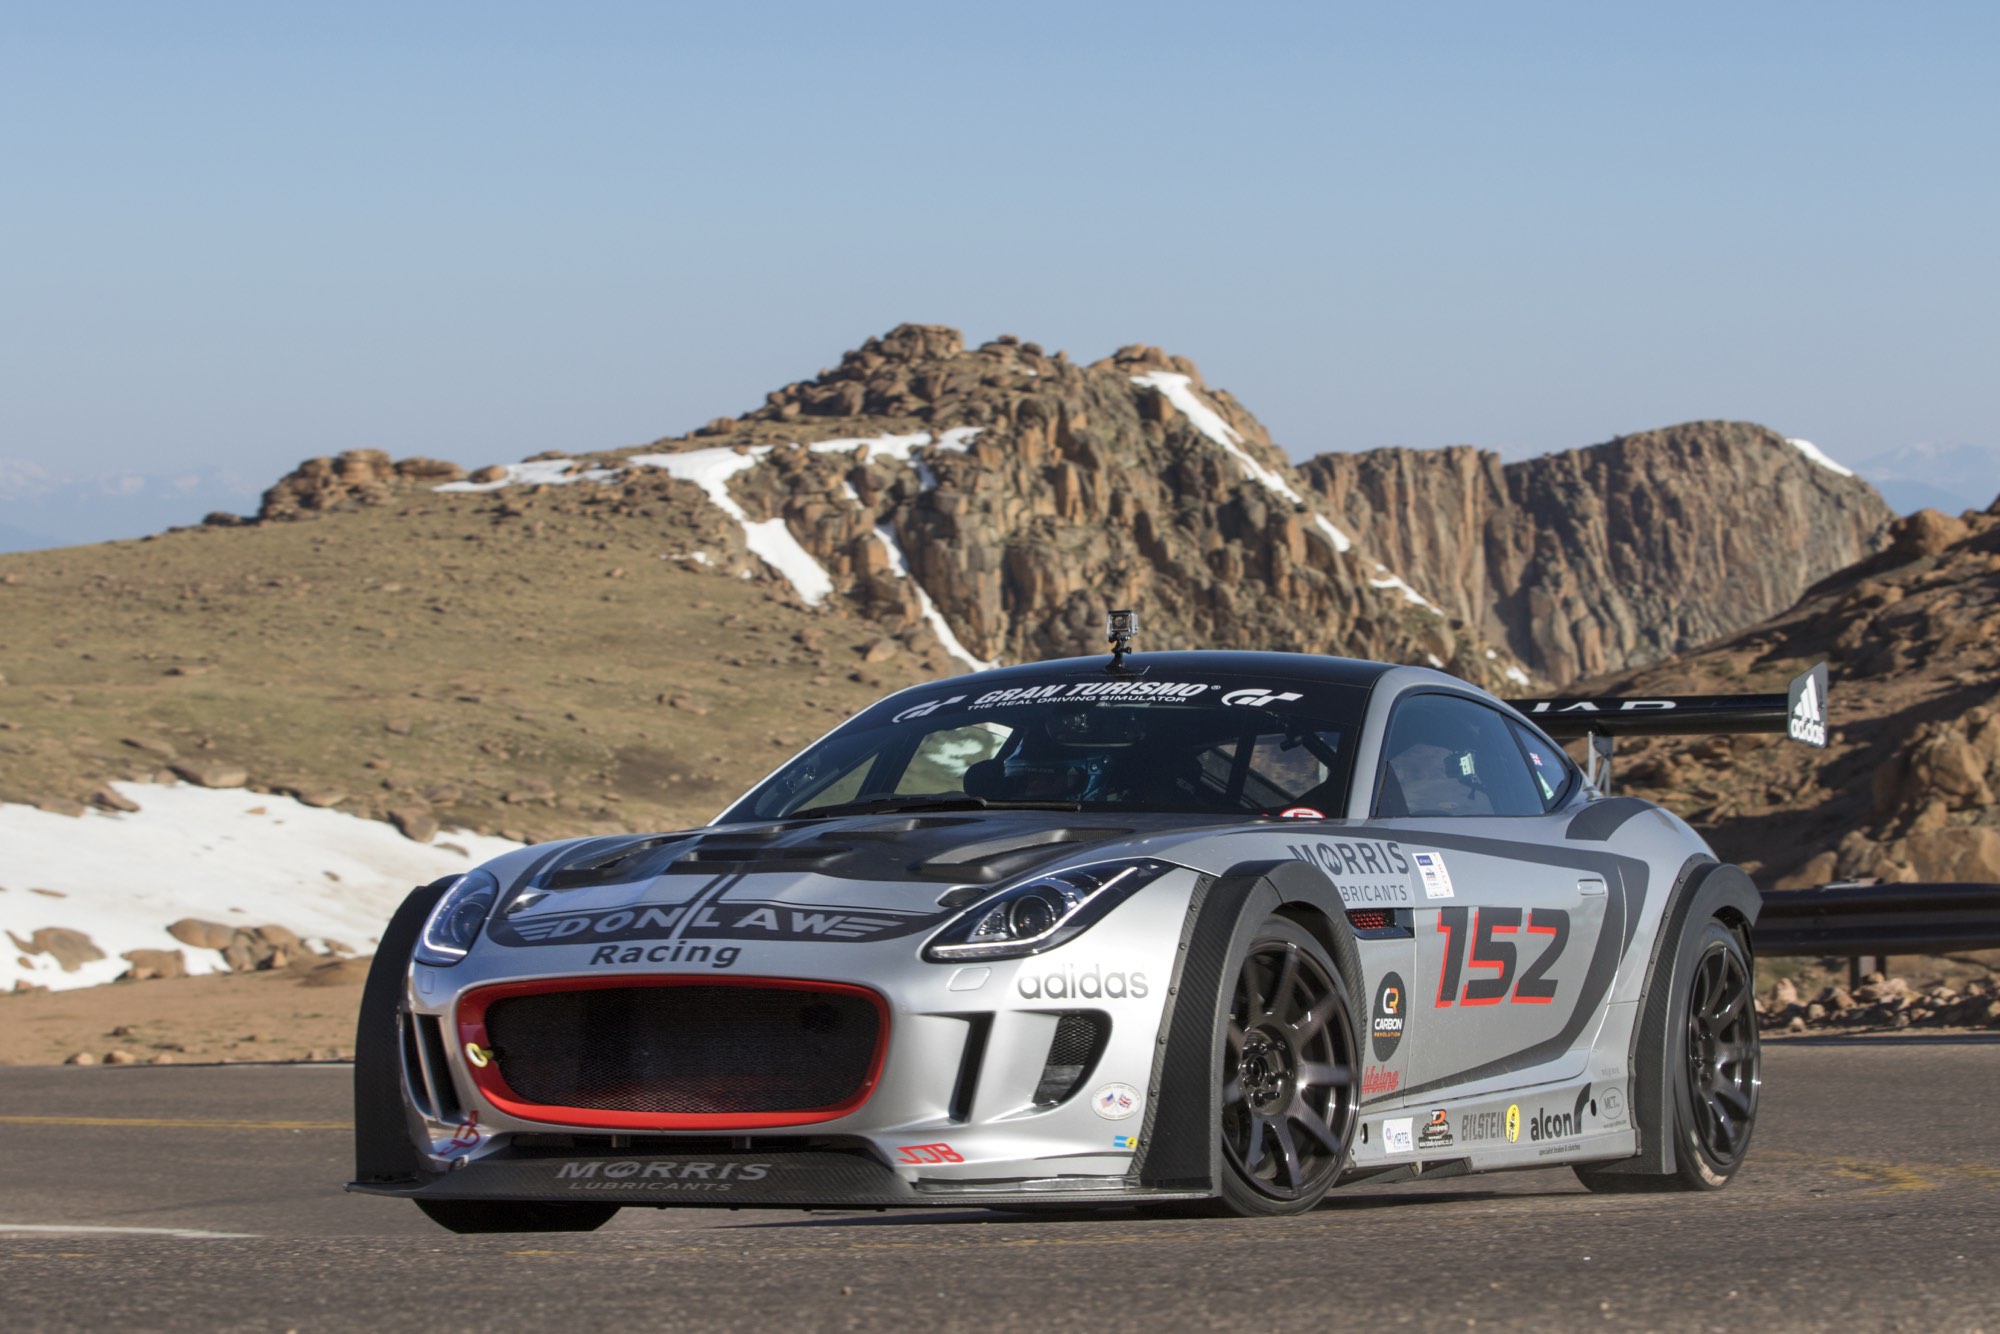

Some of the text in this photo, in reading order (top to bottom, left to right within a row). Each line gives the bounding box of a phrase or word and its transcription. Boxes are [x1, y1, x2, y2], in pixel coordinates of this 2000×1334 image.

[967, 695, 1186, 712] THE REAL DRIVING SIMULATOR
[974, 681, 1208, 705] GRAN TURISMO
[1791, 716, 1825, 746] adidas
[1287, 842, 1409, 876] MORRIS
[1342, 884, 1408, 902] BRICANTS
[553, 902, 843, 939] DON LAW
[589, 940, 742, 968] Racing
[1435, 906, 1570, 1008] 152
[1017, 963, 1149, 999] adidas
[1374, 1018, 1403, 1030] CARBON
[1461, 1111, 1508, 1141] BILSTEIN
[1530, 1107, 1573, 1141] alcon
[555, 1161, 771, 1182] MORRIS
[569, 1182, 733, 1192] LUBRICANTS
